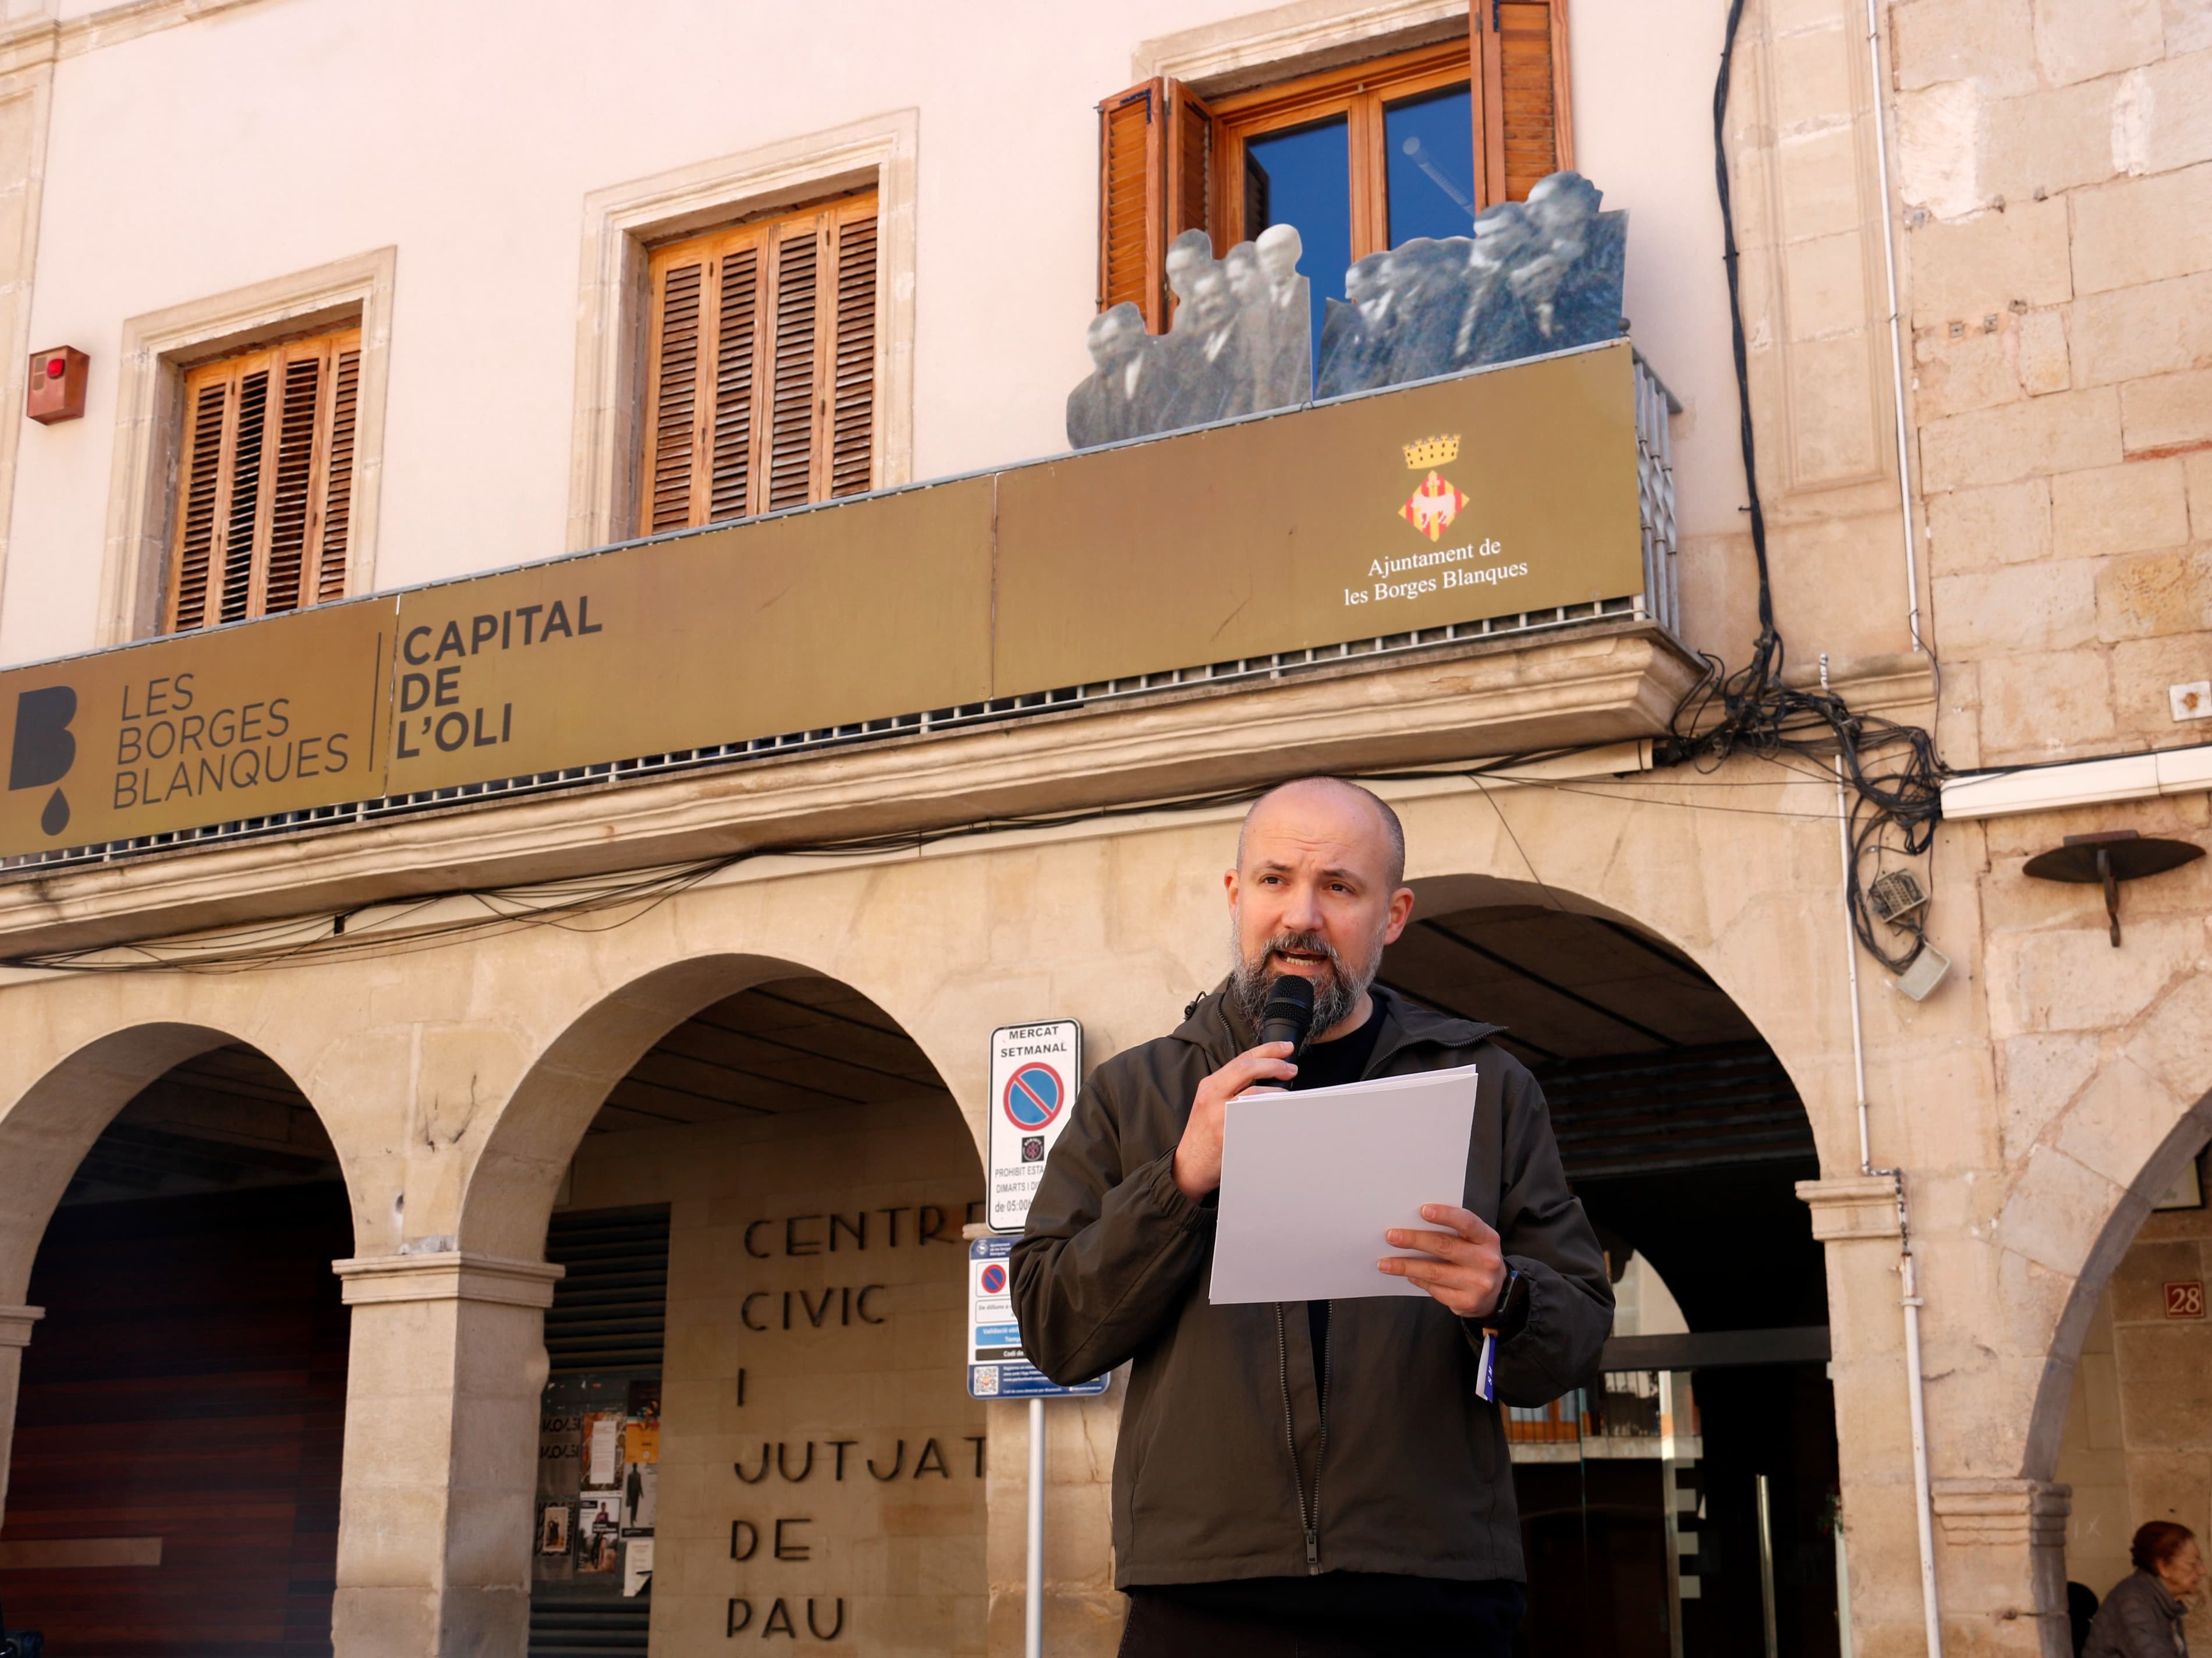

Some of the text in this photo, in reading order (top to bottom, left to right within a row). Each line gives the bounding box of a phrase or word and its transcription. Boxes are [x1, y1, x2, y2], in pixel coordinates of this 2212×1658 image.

[1368, 538, 1502, 579] Ajuntament de
[1344, 562, 1529, 606] les Borges Blanques
[402, 596, 603, 665] CAPITAL
[121, 673, 194, 721] LES
[399, 665, 462, 713] DE
[116, 698, 290, 765] BORGES
[396, 703, 513, 759] L'OLI
[114, 733, 349, 810] BLANQUES
[1000, 1043, 1068, 1058] SETMANAL
[1009, 1026, 1059, 1040] MERCAT
[995, 1165, 1044, 1178] PROHIBIT ESTA
[996, 1182, 1026, 1194] DIMARTS
[995, 1201, 1005, 1213] de
[740, 1284, 885, 1331] CIVIC
[2169, 1287, 2200, 1313] 28
[737, 1368, 746, 1407] I
[733, 1436, 986, 1484] JUTJAT
[730, 1518, 812, 1562] DE
[726, 1597, 843, 1641] PAU
